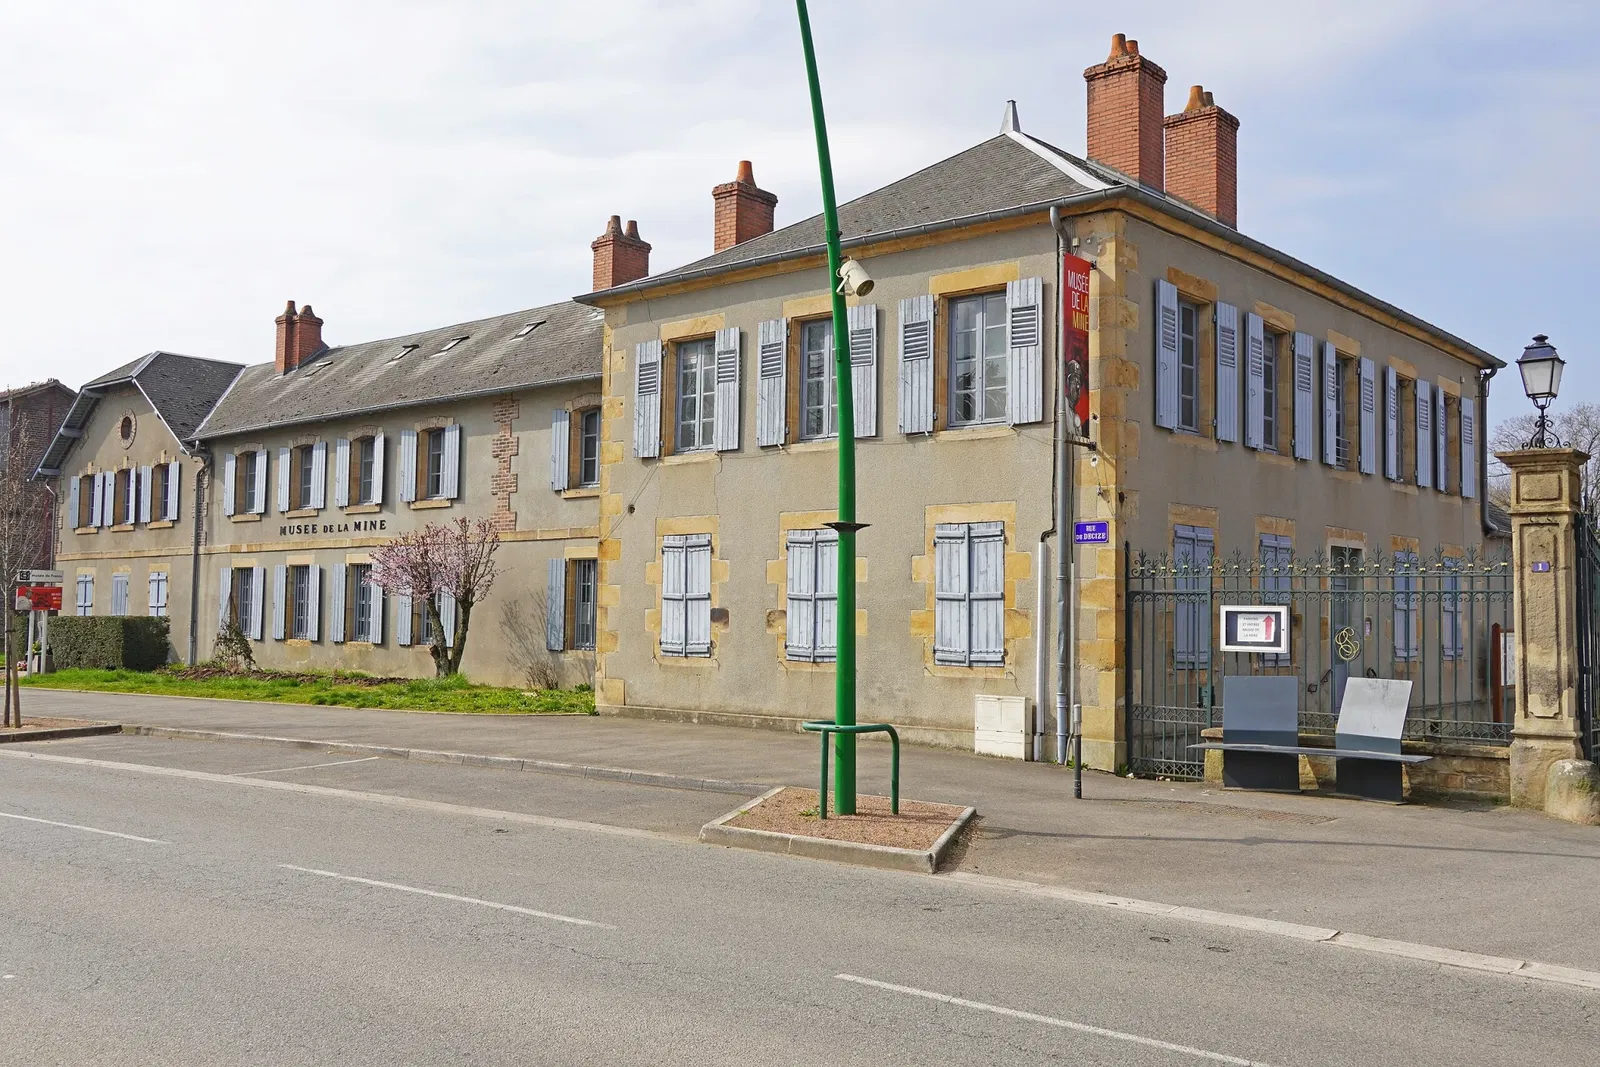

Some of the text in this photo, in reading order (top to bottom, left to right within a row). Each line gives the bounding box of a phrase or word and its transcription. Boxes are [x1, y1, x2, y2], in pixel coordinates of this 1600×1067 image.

[1068, 270, 1088, 293] MUSÉE
[1072, 291, 1088, 312] DE LA
[1073, 311, 1089, 332] MINE
[279, 520, 387, 536] MUSEE DE LA MINE
